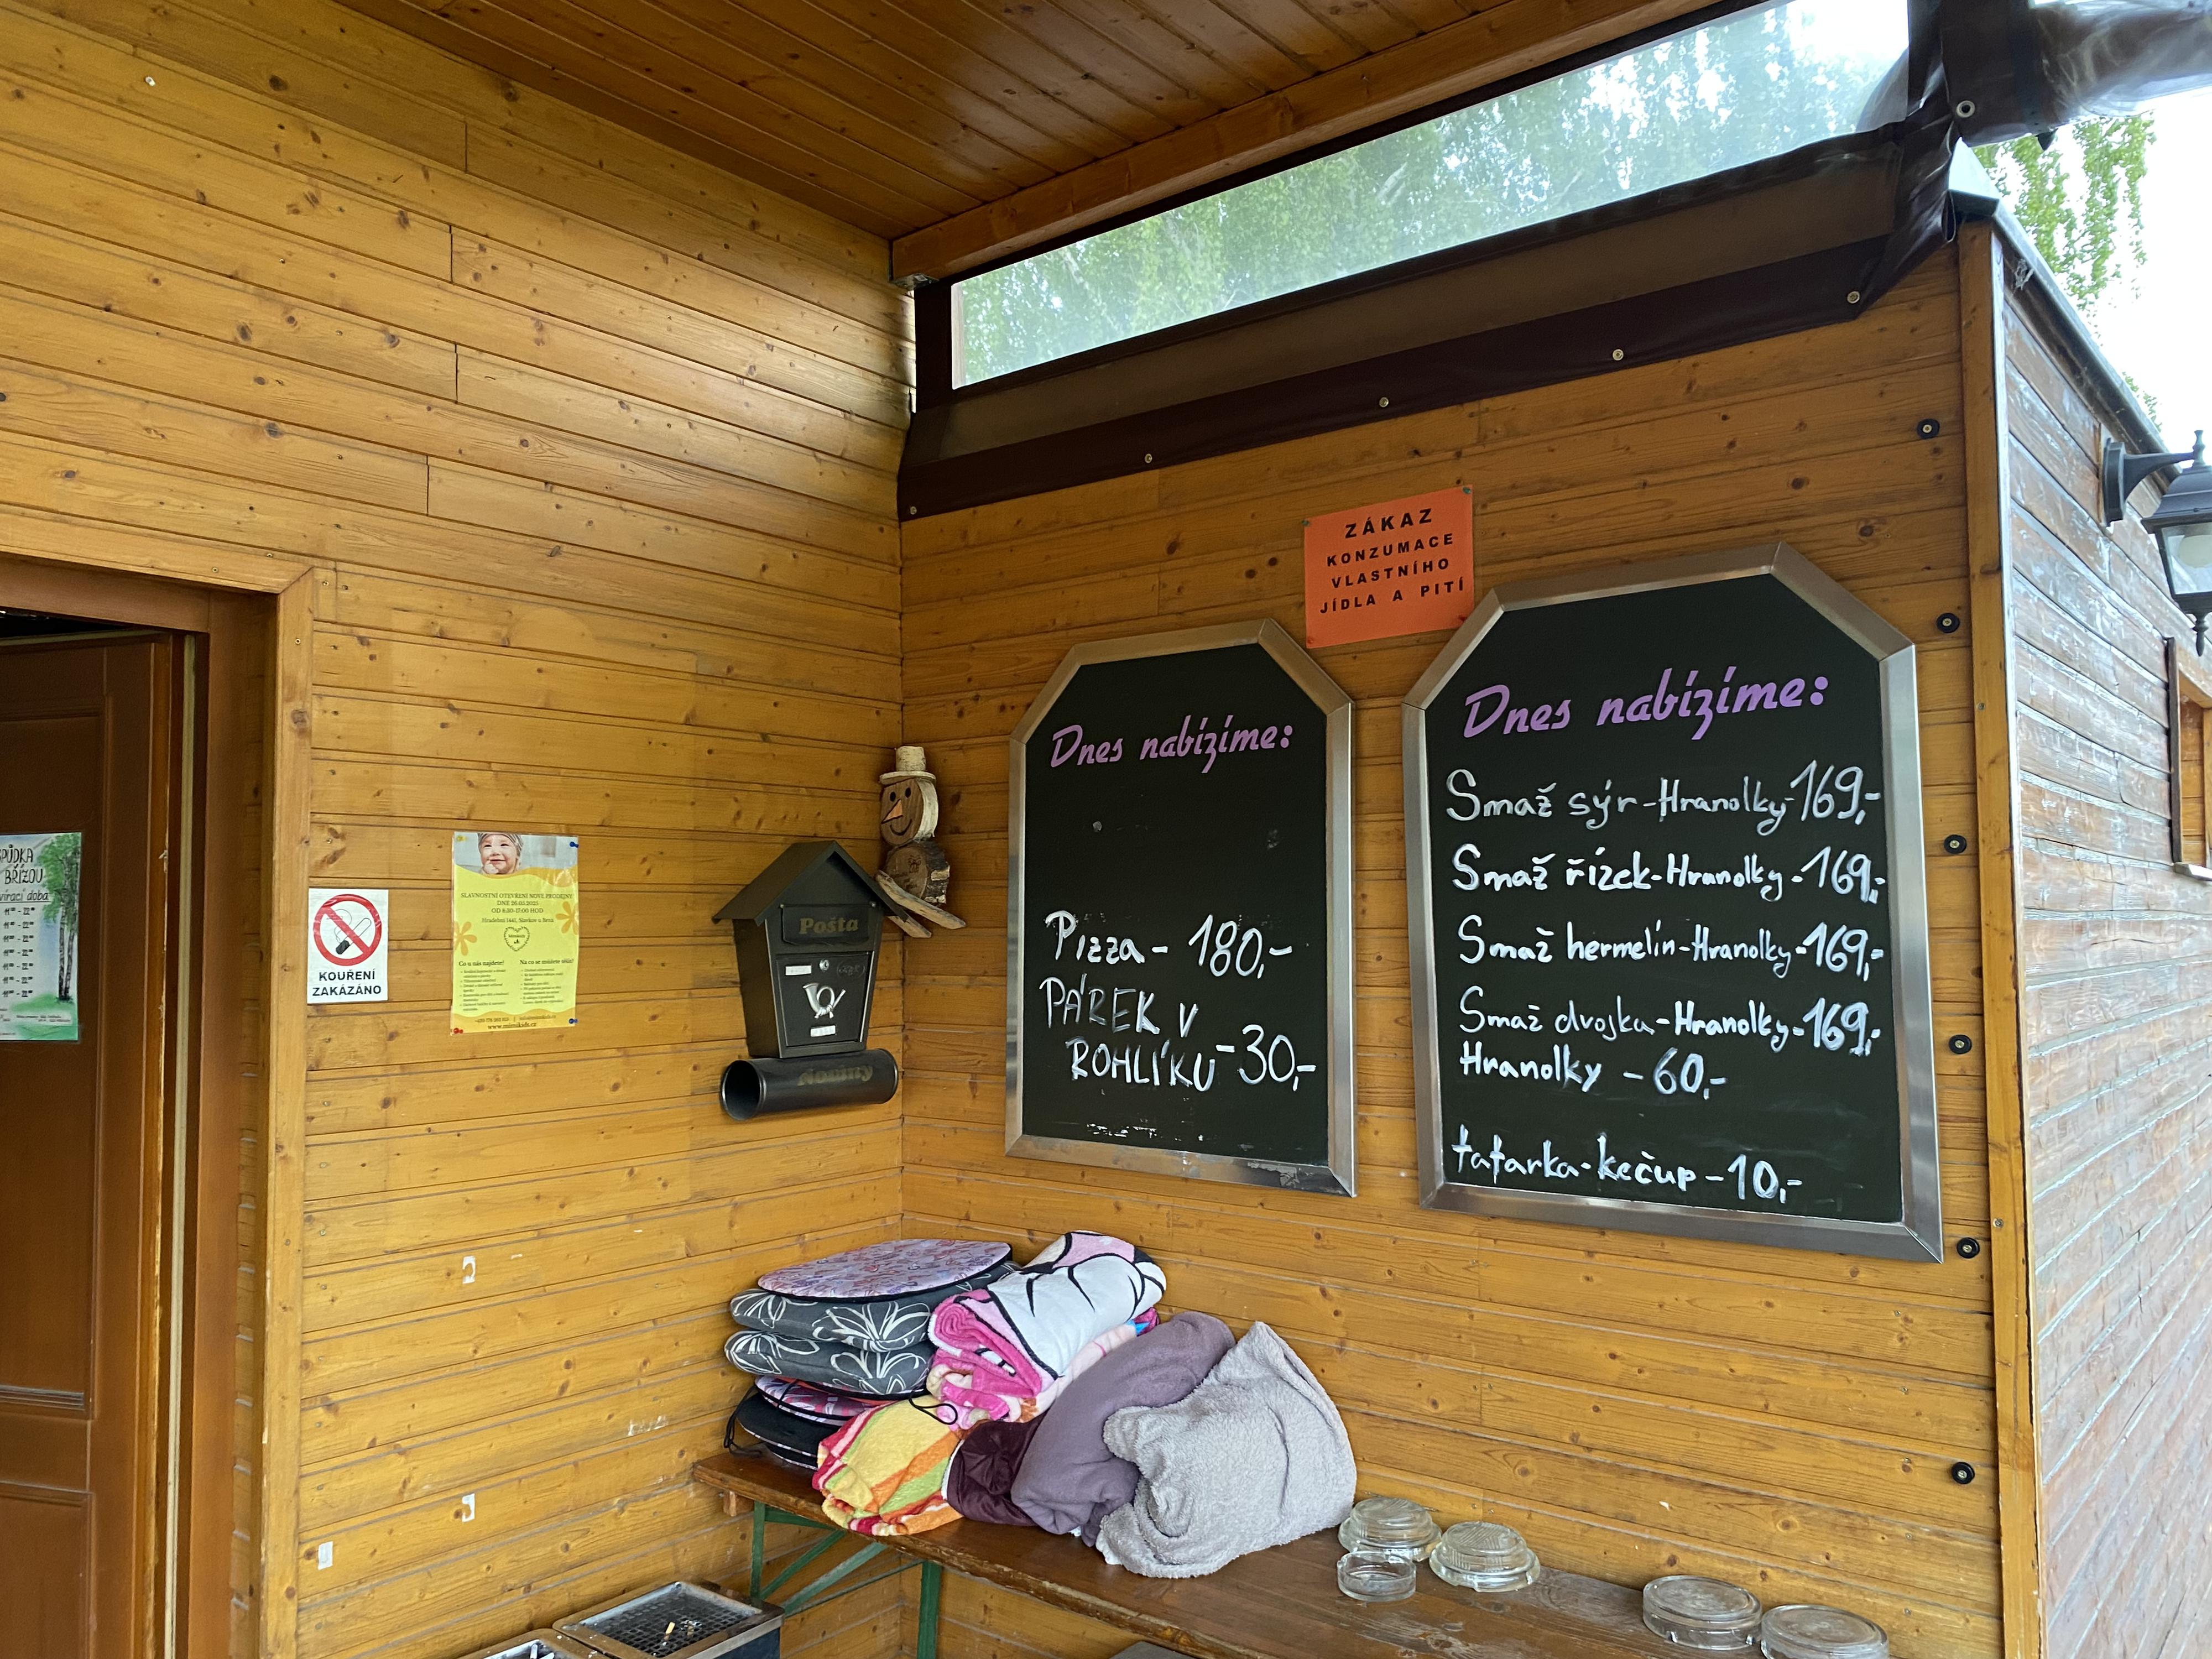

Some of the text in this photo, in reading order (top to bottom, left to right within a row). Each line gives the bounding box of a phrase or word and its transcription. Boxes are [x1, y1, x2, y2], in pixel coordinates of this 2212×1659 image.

[1344, 508, 1432, 539] ZÁKAZ
[1327, 533, 1453, 567] KONZUMACE
[1331, 558, 1449, 588] VLASTNÍHO
[1319, 576, 1463, 614] JÍDLA A PITÍ
[1464, 665, 1828, 740] Dnes nabízíme:
[1051, 714, 1293, 774] Dnes nabízíme:
[1446, 769, 1557, 821] Smaž
[1452, 843, 1556, 891] Smaž
[27, 889, 49, 901] doba
[799, 916, 859, 935] Pošta
[1458, 914, 1554, 964] Smaž
[312, 984, 382, 997] ZAKÁZÁNO
[319, 968, 375, 981] KOUŘENÍ
[1039, 973, 1161, 1035] PÁREK
[1459, 985, 1543, 1033] Smaž
[1459, 1040, 1602, 1093] Hranolky
